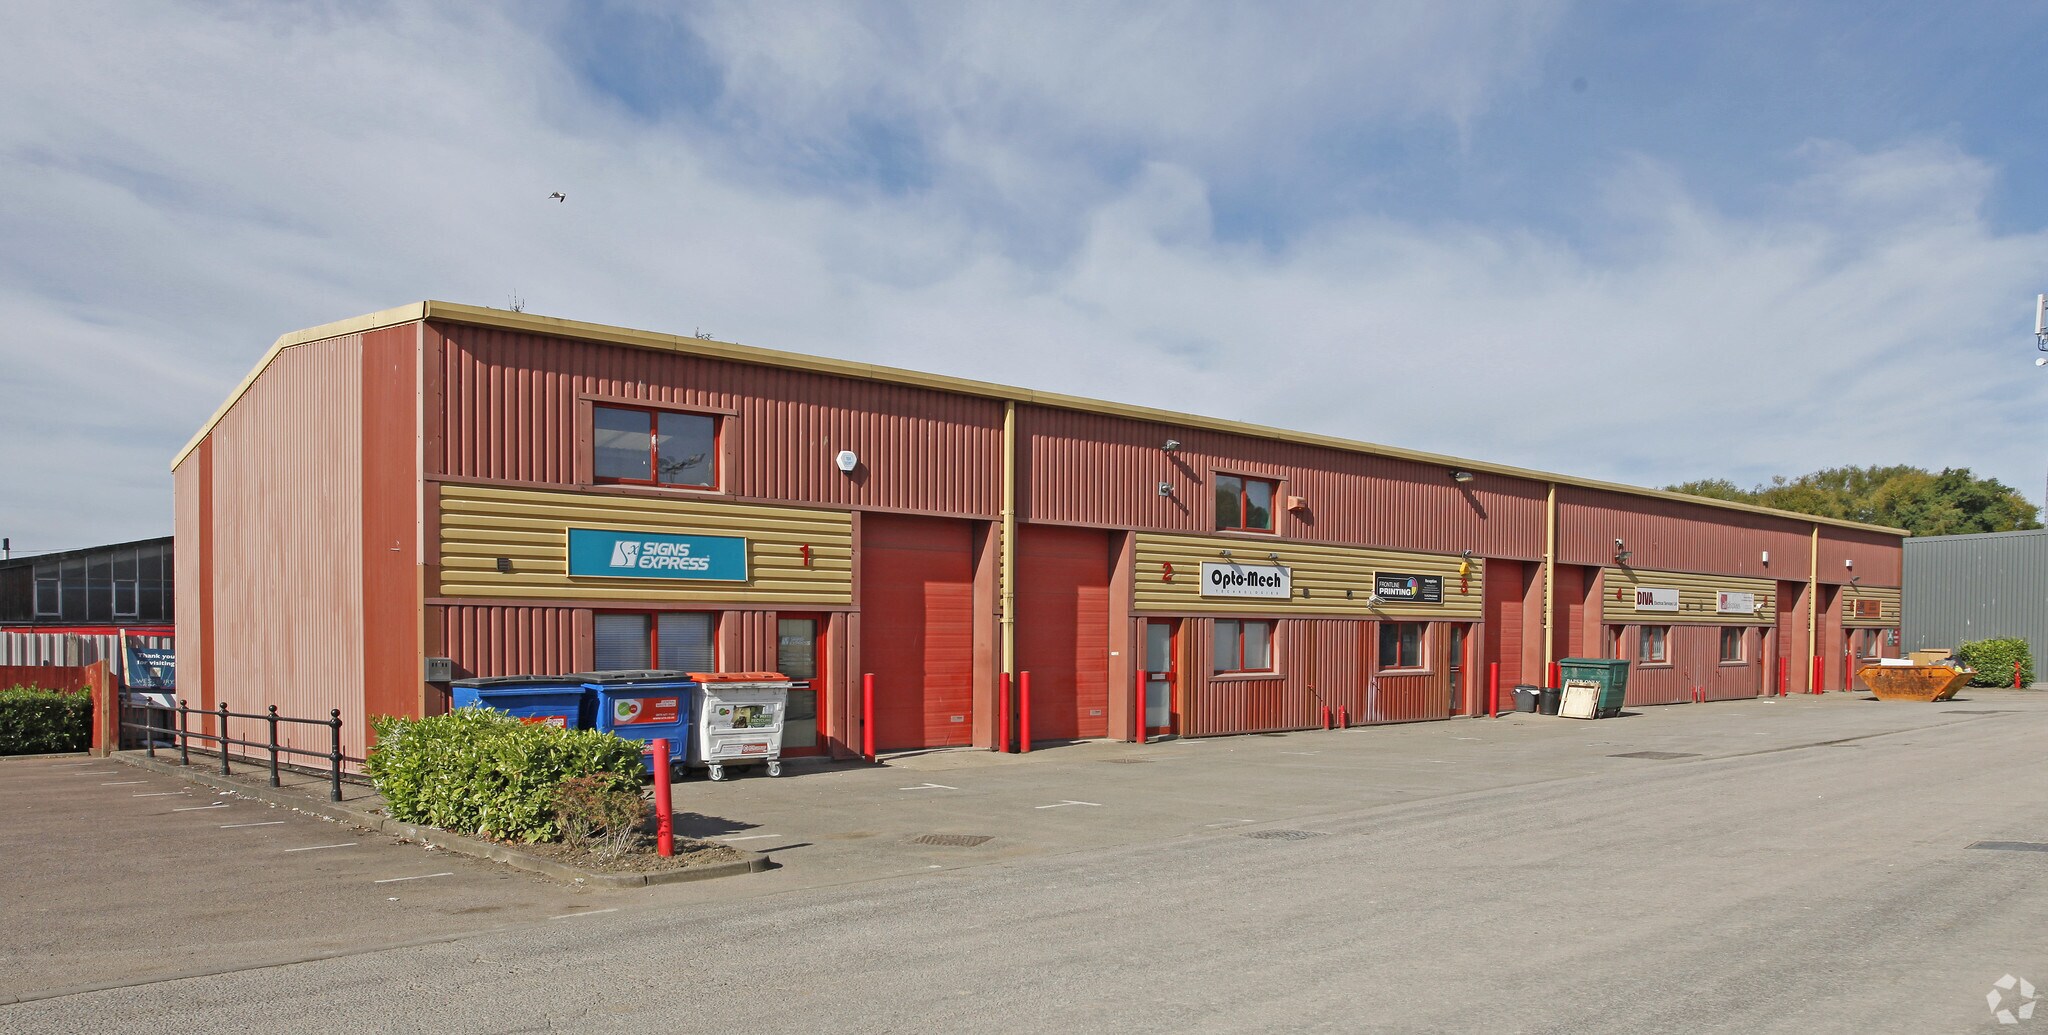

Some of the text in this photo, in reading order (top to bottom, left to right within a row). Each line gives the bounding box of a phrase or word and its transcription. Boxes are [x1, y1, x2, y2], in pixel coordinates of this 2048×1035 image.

[642, 542, 690, 556] SIGNS
[800, 544, 809, 566] 1
[639, 556, 710, 570] EXPRESS
[1162, 561, 1172, 582] 2
[1211, 569, 1281, 589] Opto-Mech
[1379, 588, 1411, 596] PRINTING
[1637, 592, 1653, 606] DIVA
